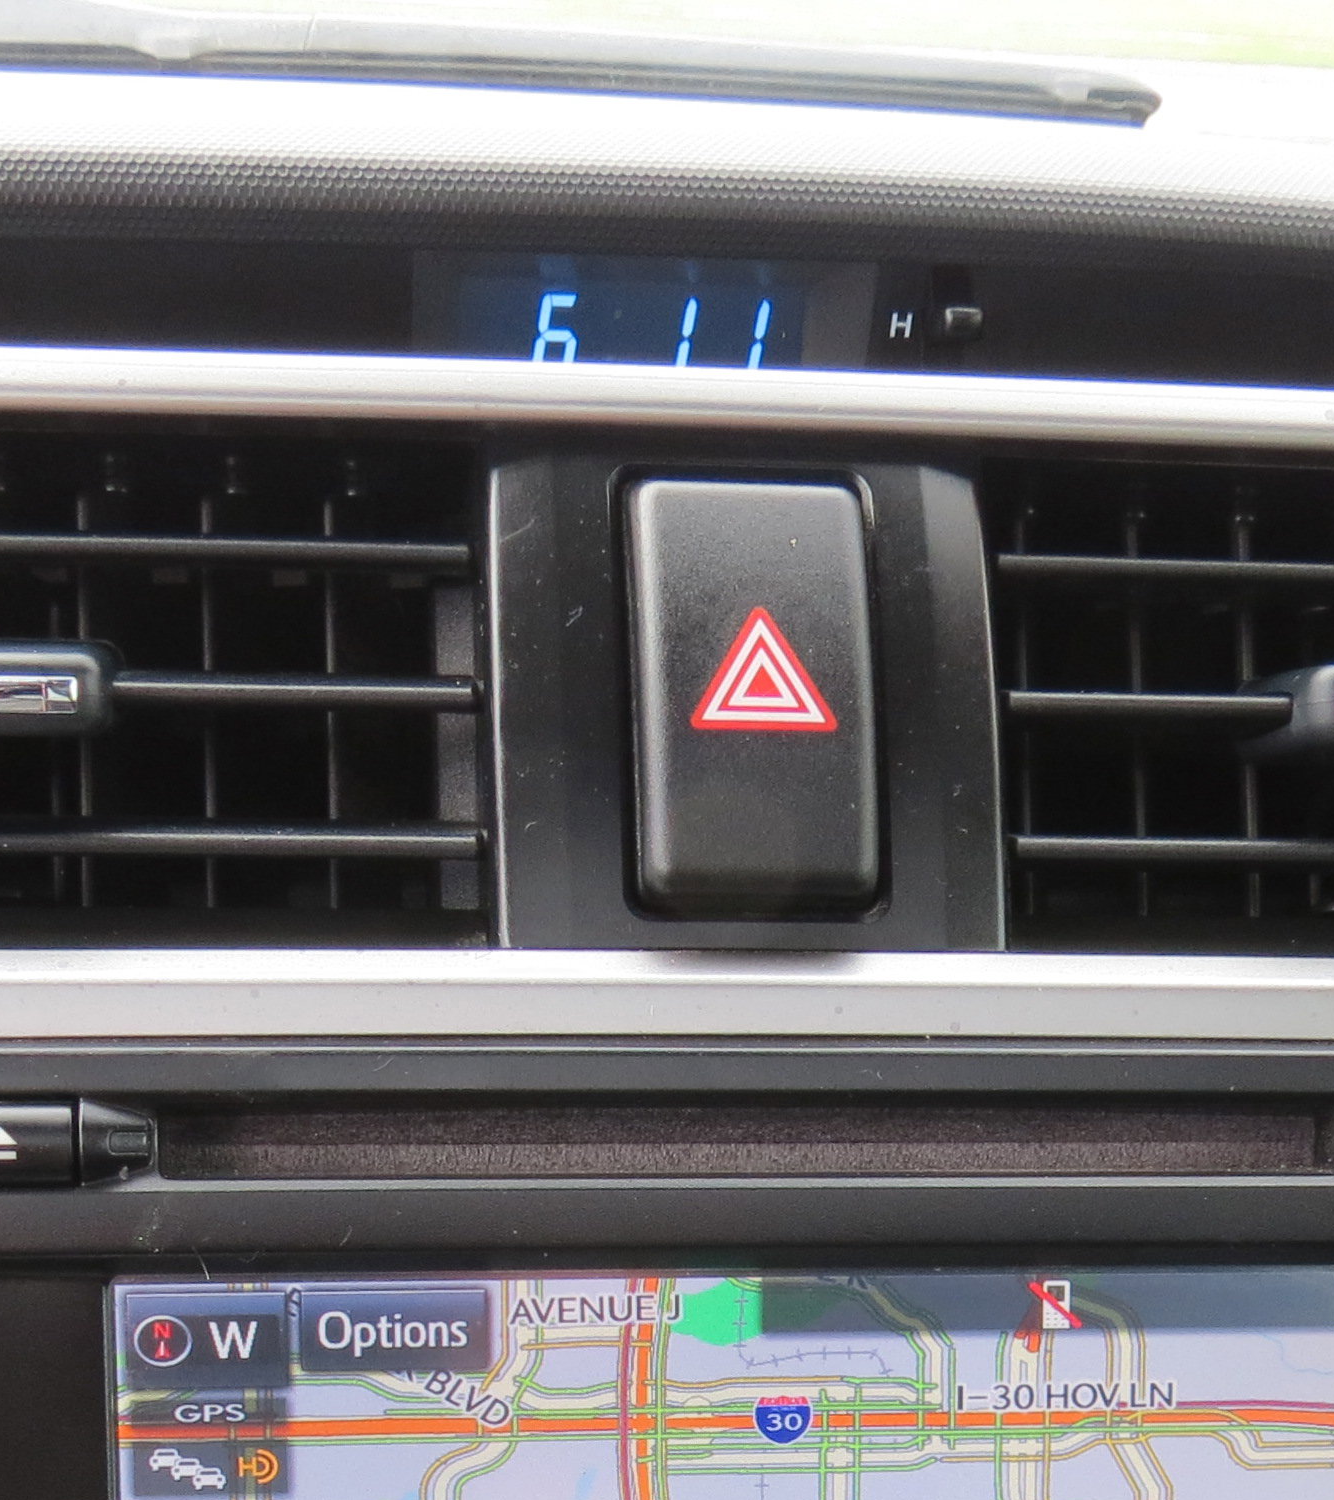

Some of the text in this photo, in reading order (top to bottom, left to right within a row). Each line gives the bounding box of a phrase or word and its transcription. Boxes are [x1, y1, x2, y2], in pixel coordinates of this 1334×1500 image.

[888, 311, 914, 339] H
[509, 1294, 682, 1325] AVENUE J
[207, 1320, 259, 1361] W
[317, 1310, 469, 1358] Options
[424, 1369, 510, 1428] BLVD
[957, 1382, 1174, 1411] I-30 HOV LN
[174, 1403, 246, 1424] GPS
[766, 1412, 803, 1432] 30
